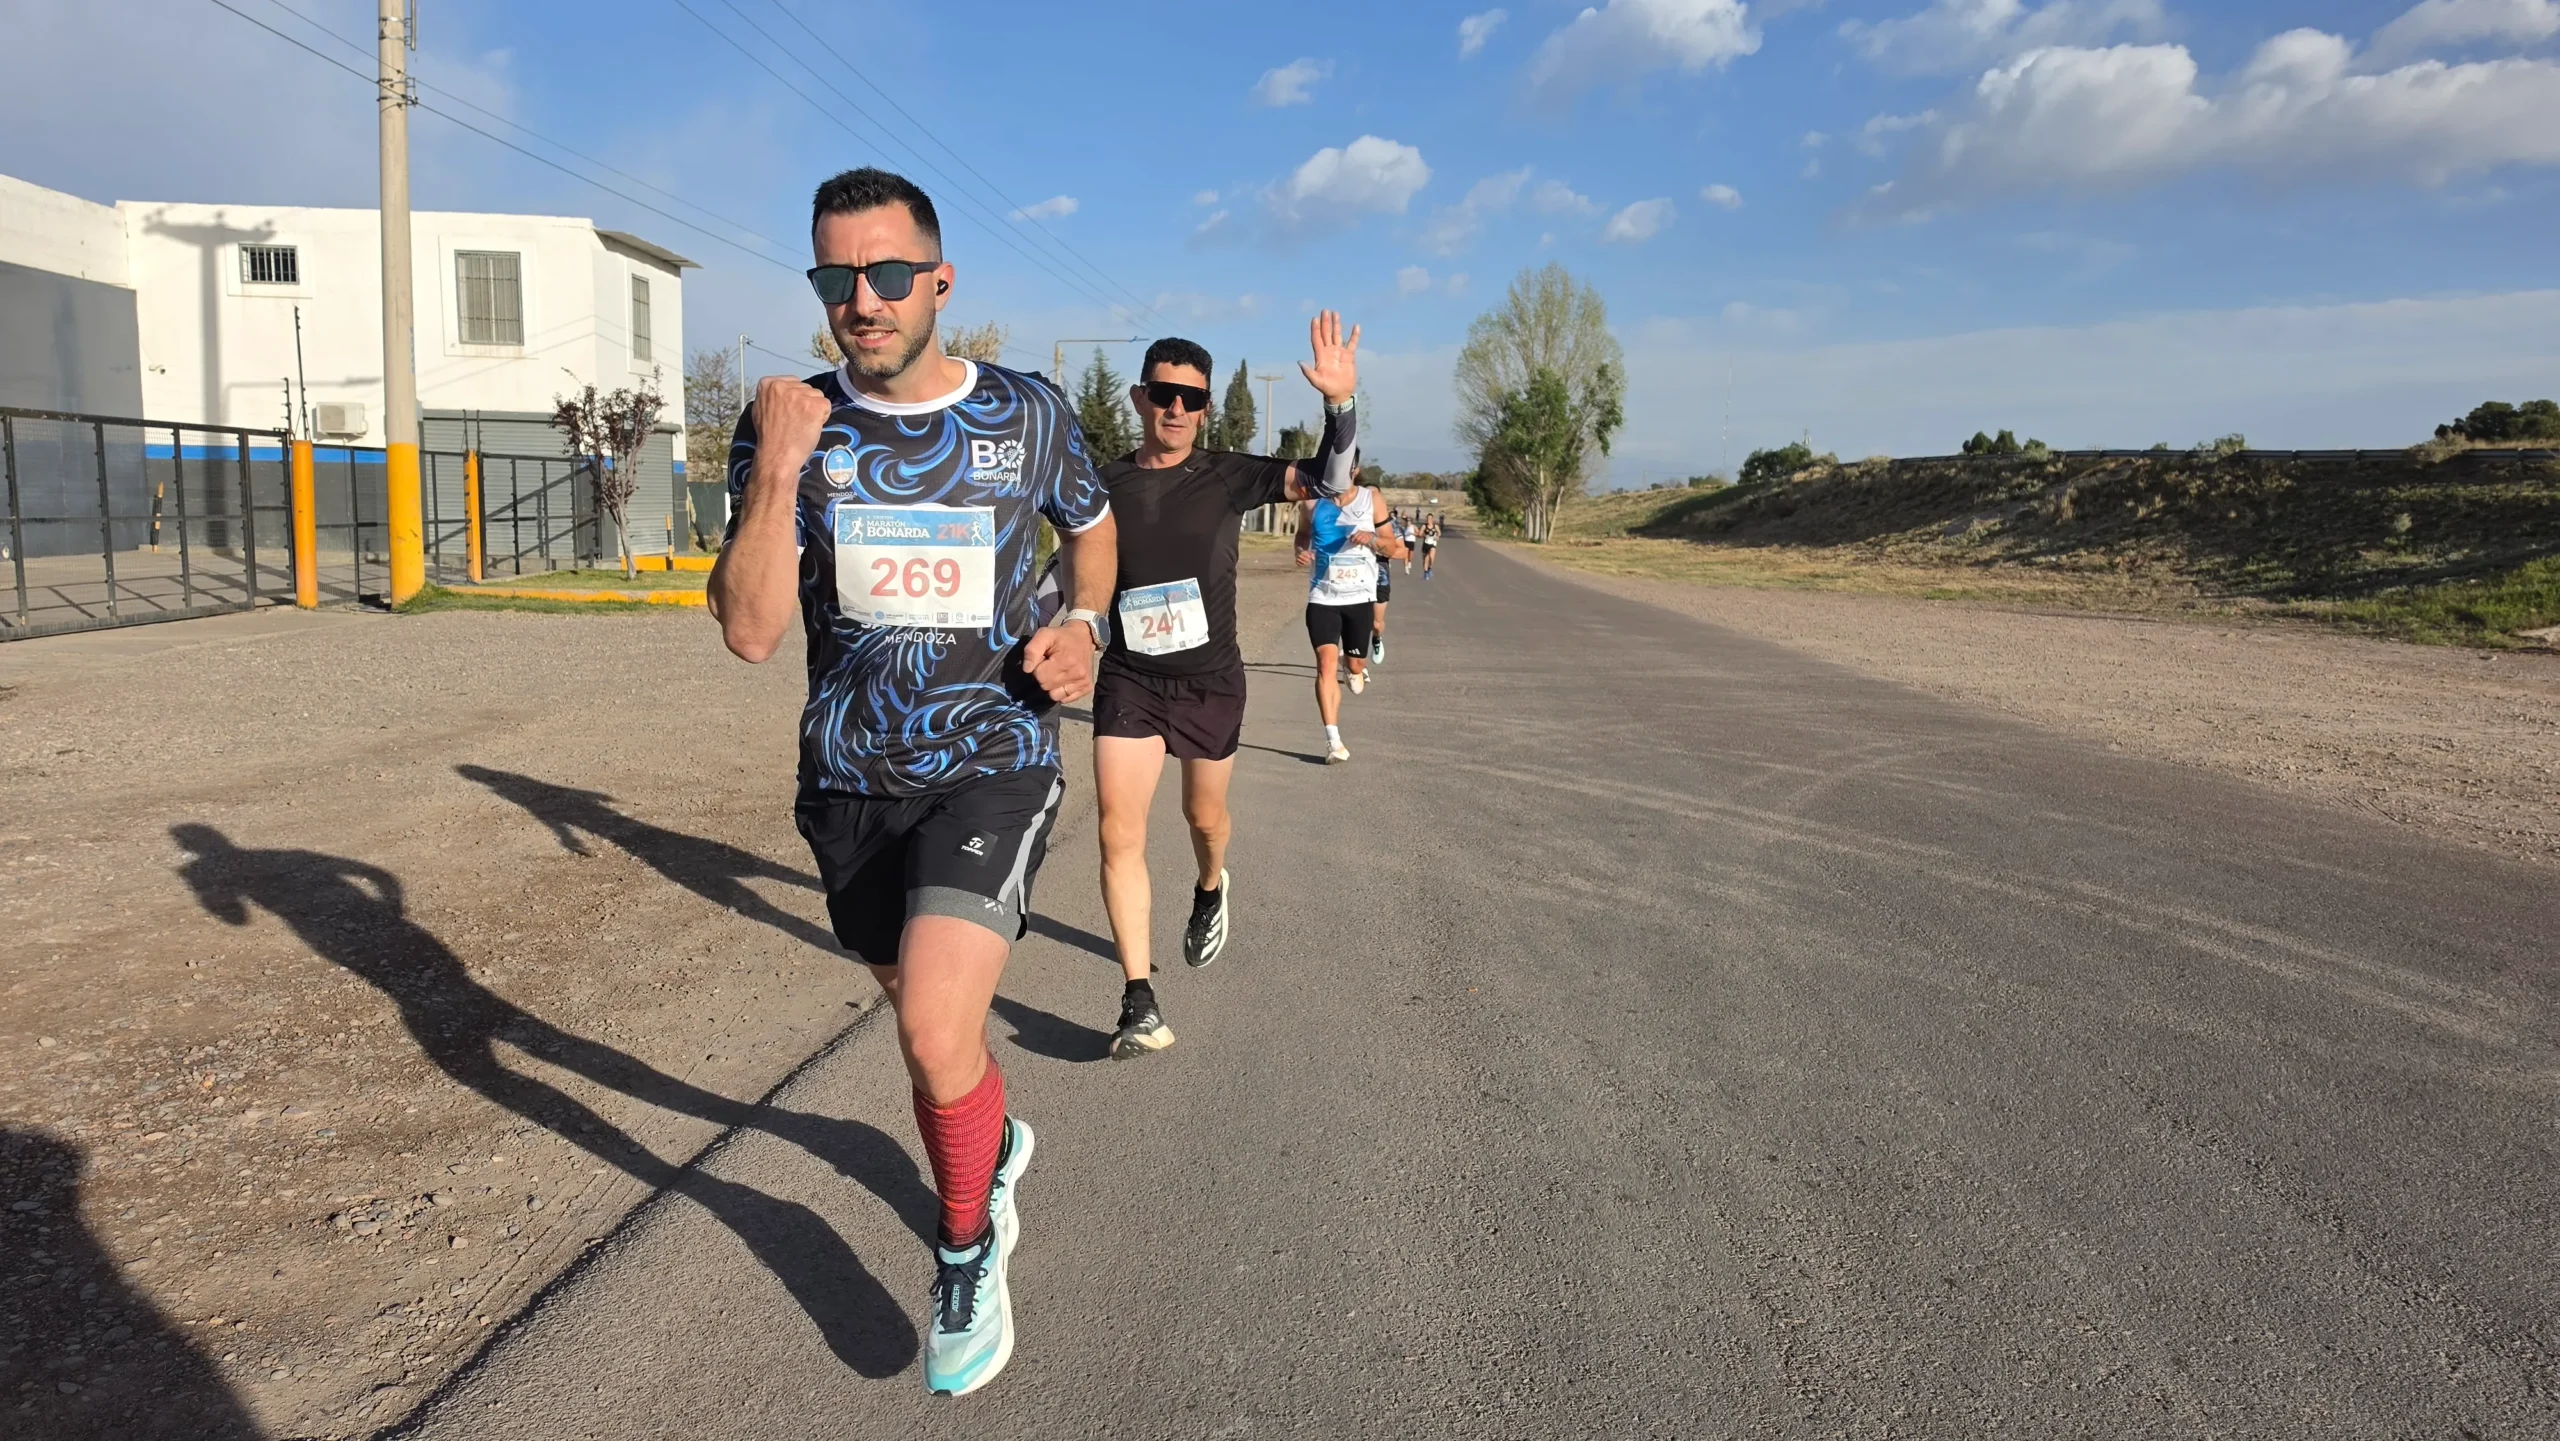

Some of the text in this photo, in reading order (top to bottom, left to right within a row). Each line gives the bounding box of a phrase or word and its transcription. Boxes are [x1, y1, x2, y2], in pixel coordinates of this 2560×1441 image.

[973, 471, 1021, 482] BONARDA
[866, 519, 906, 527] MARATÓN
[866, 523, 971, 540] BONARDA 21K
[870, 557, 961, 598] 269
[1337, 568, 1358, 579] 243
[1132, 595, 1165, 606] BONARDA
[1140, 610, 1185, 639] 241
[884, 631, 957, 645] MENDOZA
